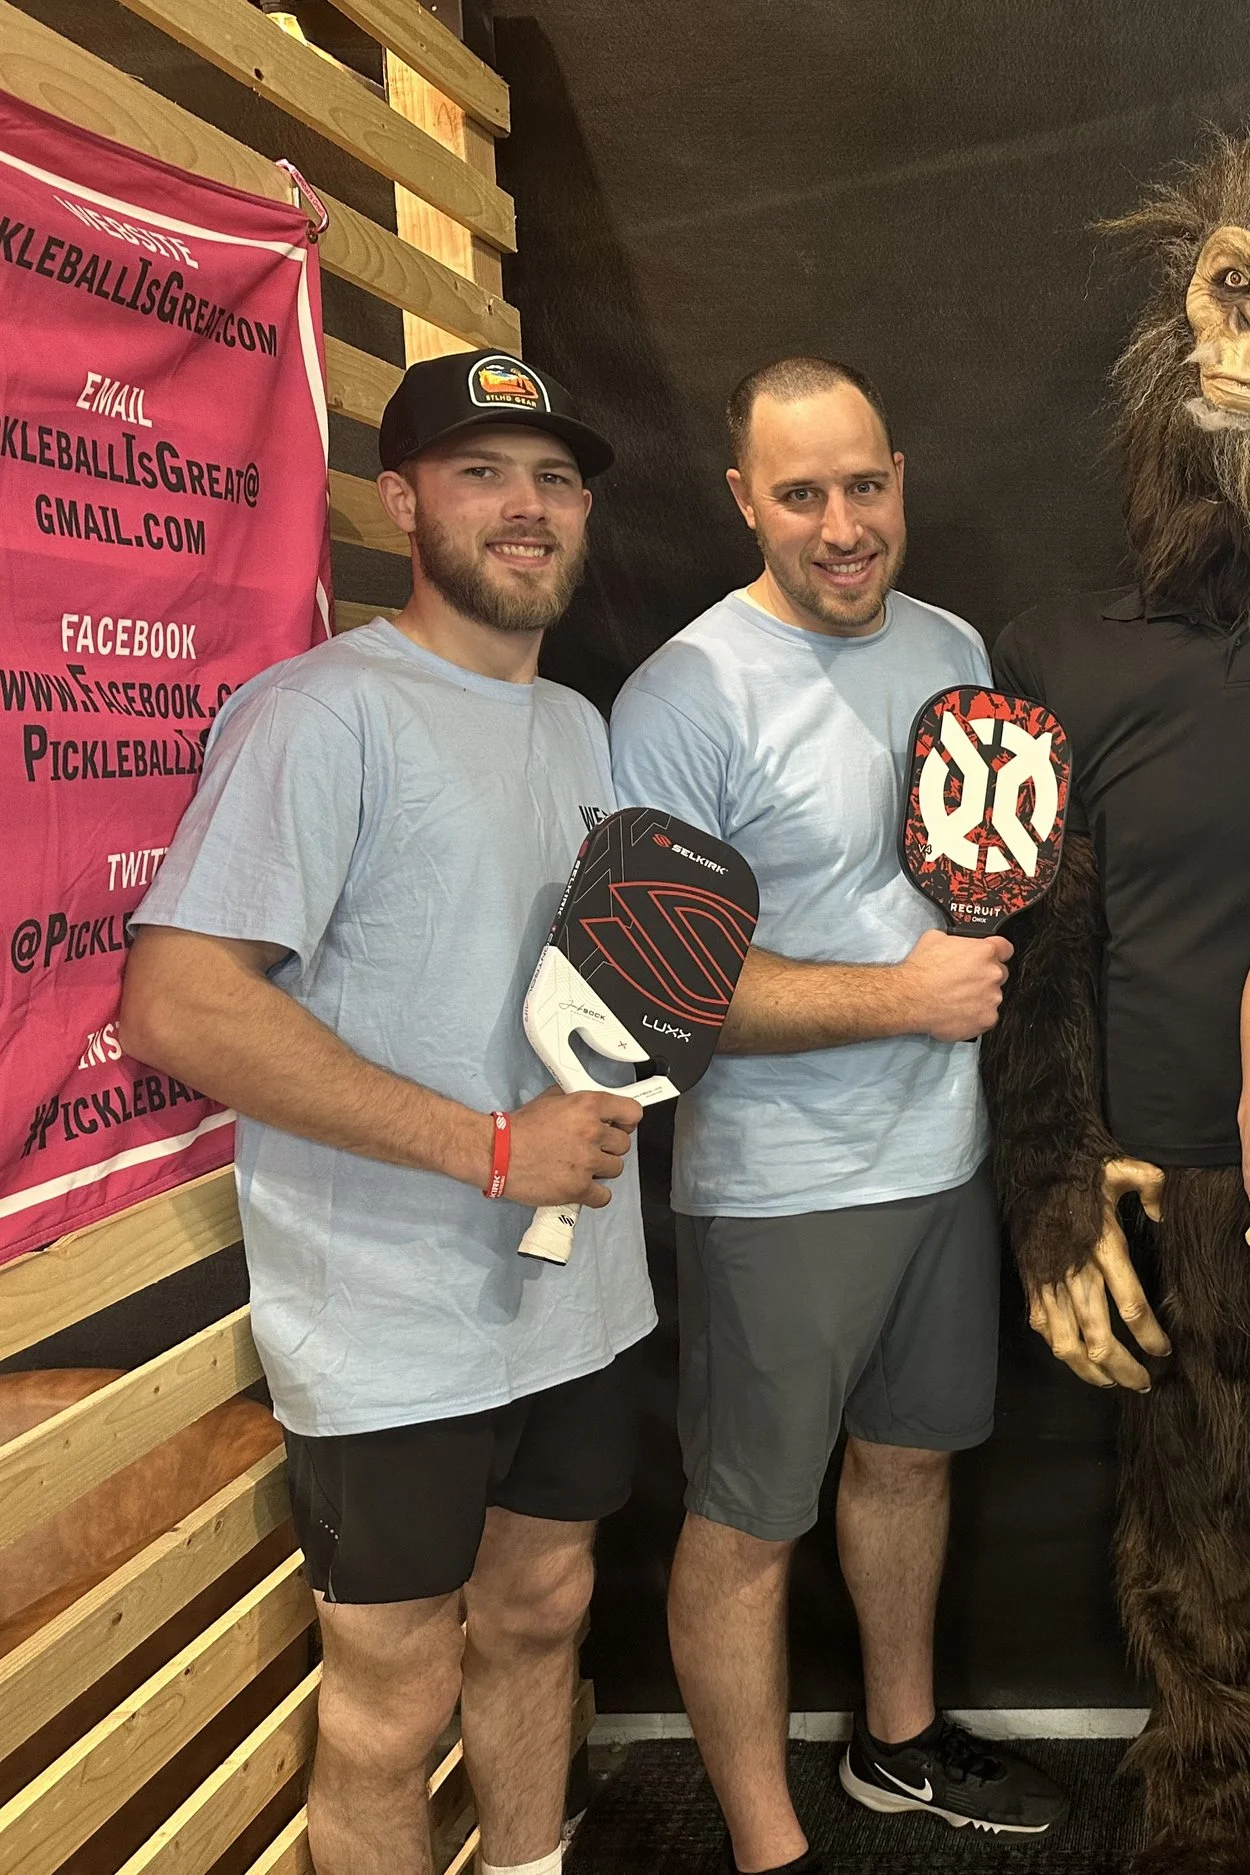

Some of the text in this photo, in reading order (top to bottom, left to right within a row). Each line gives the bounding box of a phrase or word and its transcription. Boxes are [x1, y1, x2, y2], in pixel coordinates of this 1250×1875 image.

[53, 194, 199, 270] WEBSITE
[76, 371, 153, 428] EMAIL
[486, 394, 537, 408] STLHD GEAR
[35, 493, 206, 556] GMAIL.COM
[61, 613, 197, 660] FACEBOOK
[0, 663, 245, 720] WWW.FACEBOOK.C
[107, 847, 169, 892] TWIT
[671, 844, 729, 875] SELKIRK
[950, 902, 1001, 918] RECRUIT
[78, 1021, 123, 1070] INS
[642, 1014, 693, 1043] LUXX
